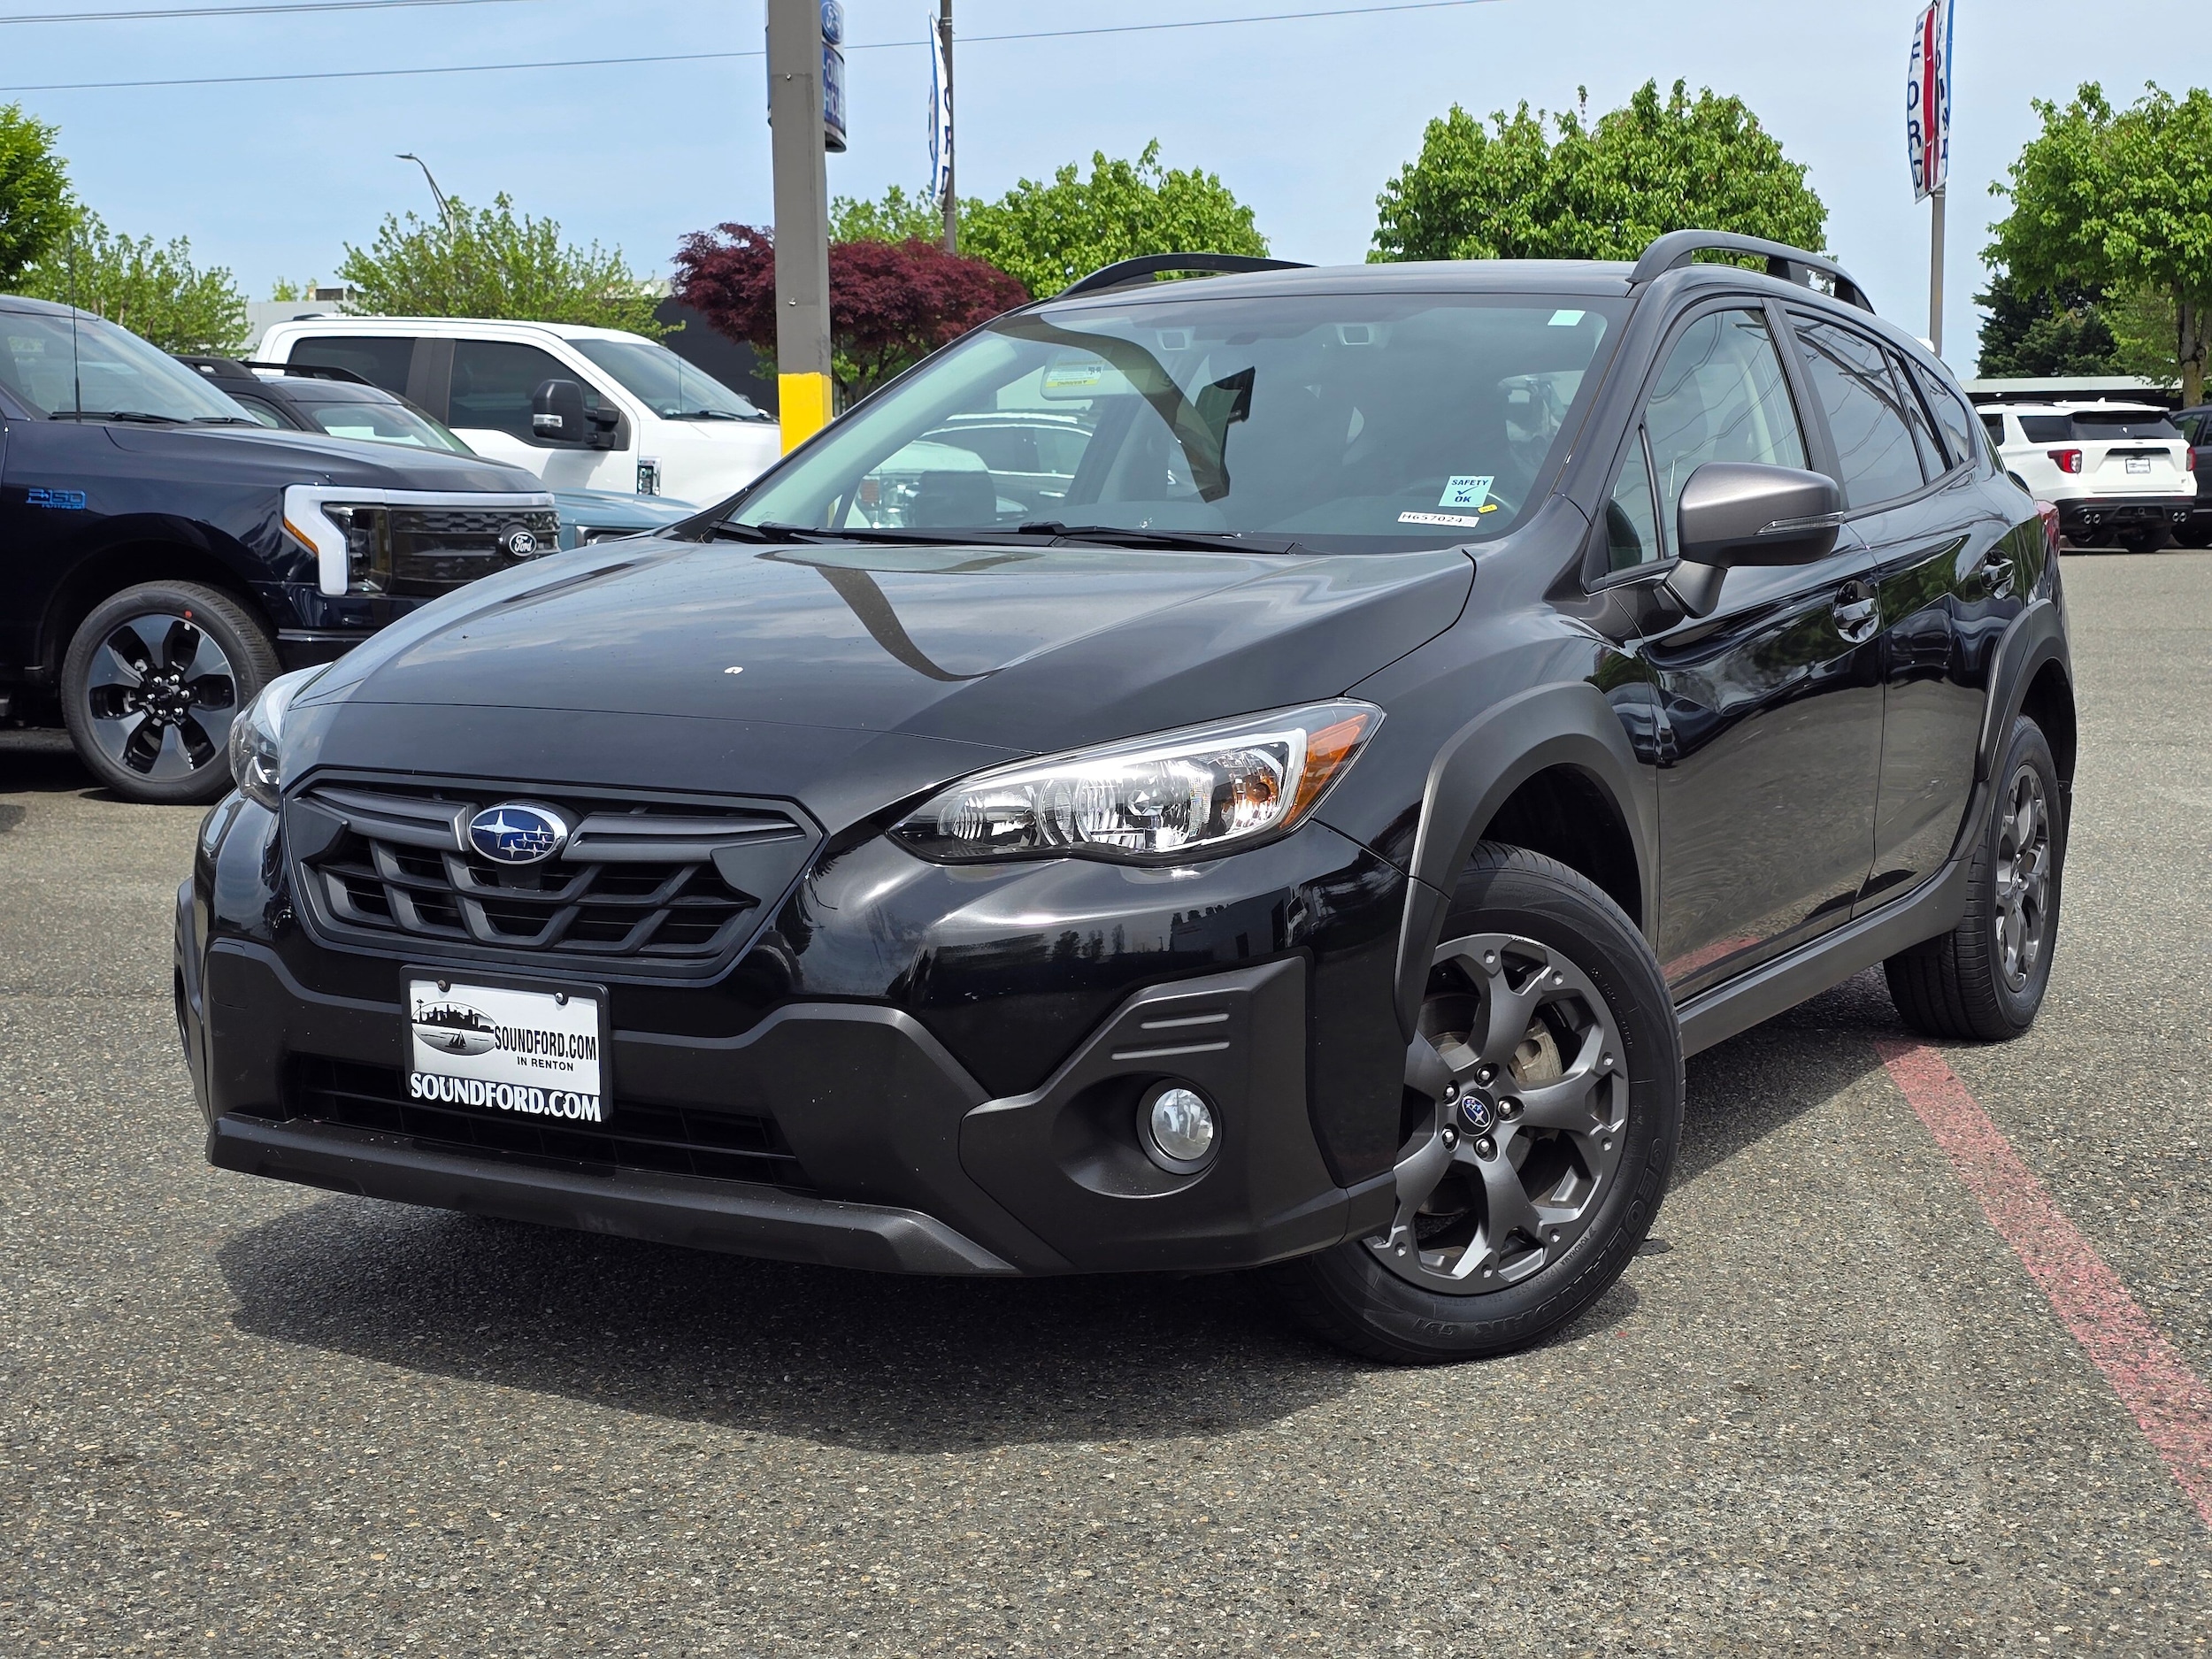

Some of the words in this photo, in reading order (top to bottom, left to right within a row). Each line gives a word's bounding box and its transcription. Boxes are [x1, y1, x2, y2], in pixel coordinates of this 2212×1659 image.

[514, 534, 533, 552] Ford
[495, 1025, 596, 1061] SOUNDFORD.COM
[517, 1056, 527, 1066] IN
[531, 1058, 573, 1071] RENTON
[410, 1072, 602, 1122] SOUNDFORD.COM
[1560, 1234, 1593, 1266] YOKOHAMA
